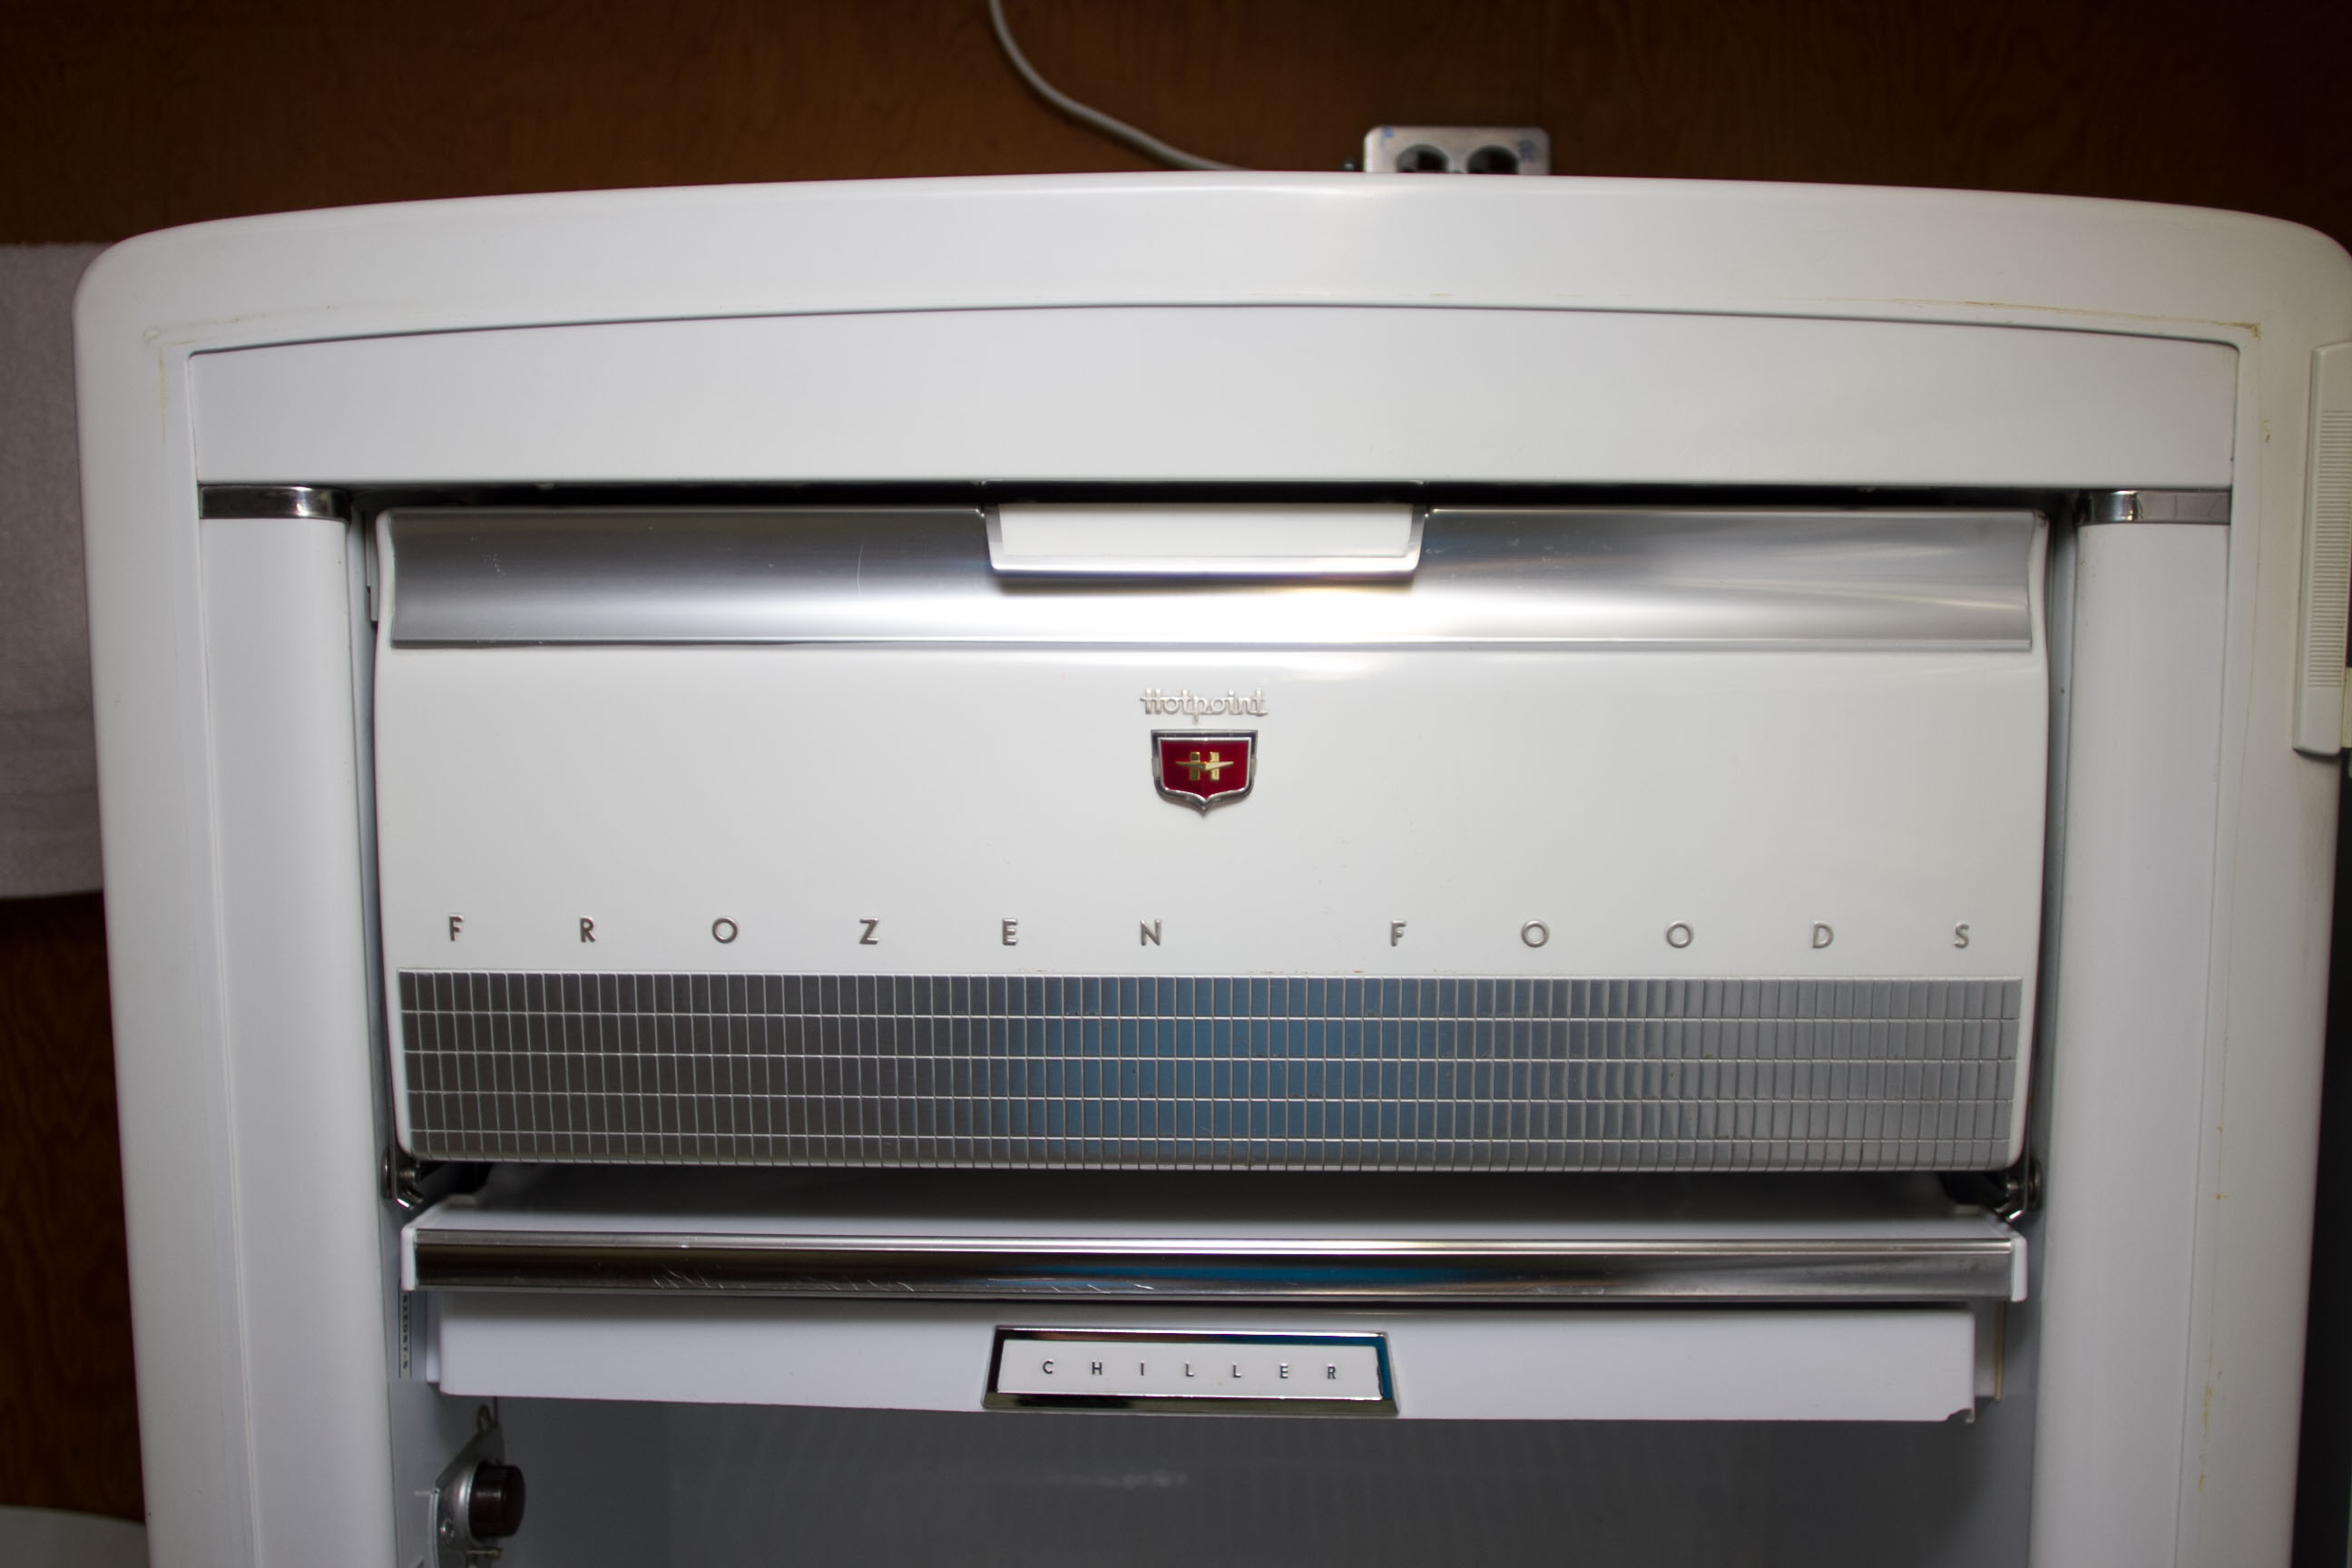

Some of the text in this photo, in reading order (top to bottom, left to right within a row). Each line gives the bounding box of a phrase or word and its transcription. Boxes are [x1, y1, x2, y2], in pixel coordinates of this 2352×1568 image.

[1140, 689, 1269, 724] Hotpoint
[447, 915, 1971, 949] FROZEN FOODS
[1043, 1359, 1337, 1380] CHILLER
